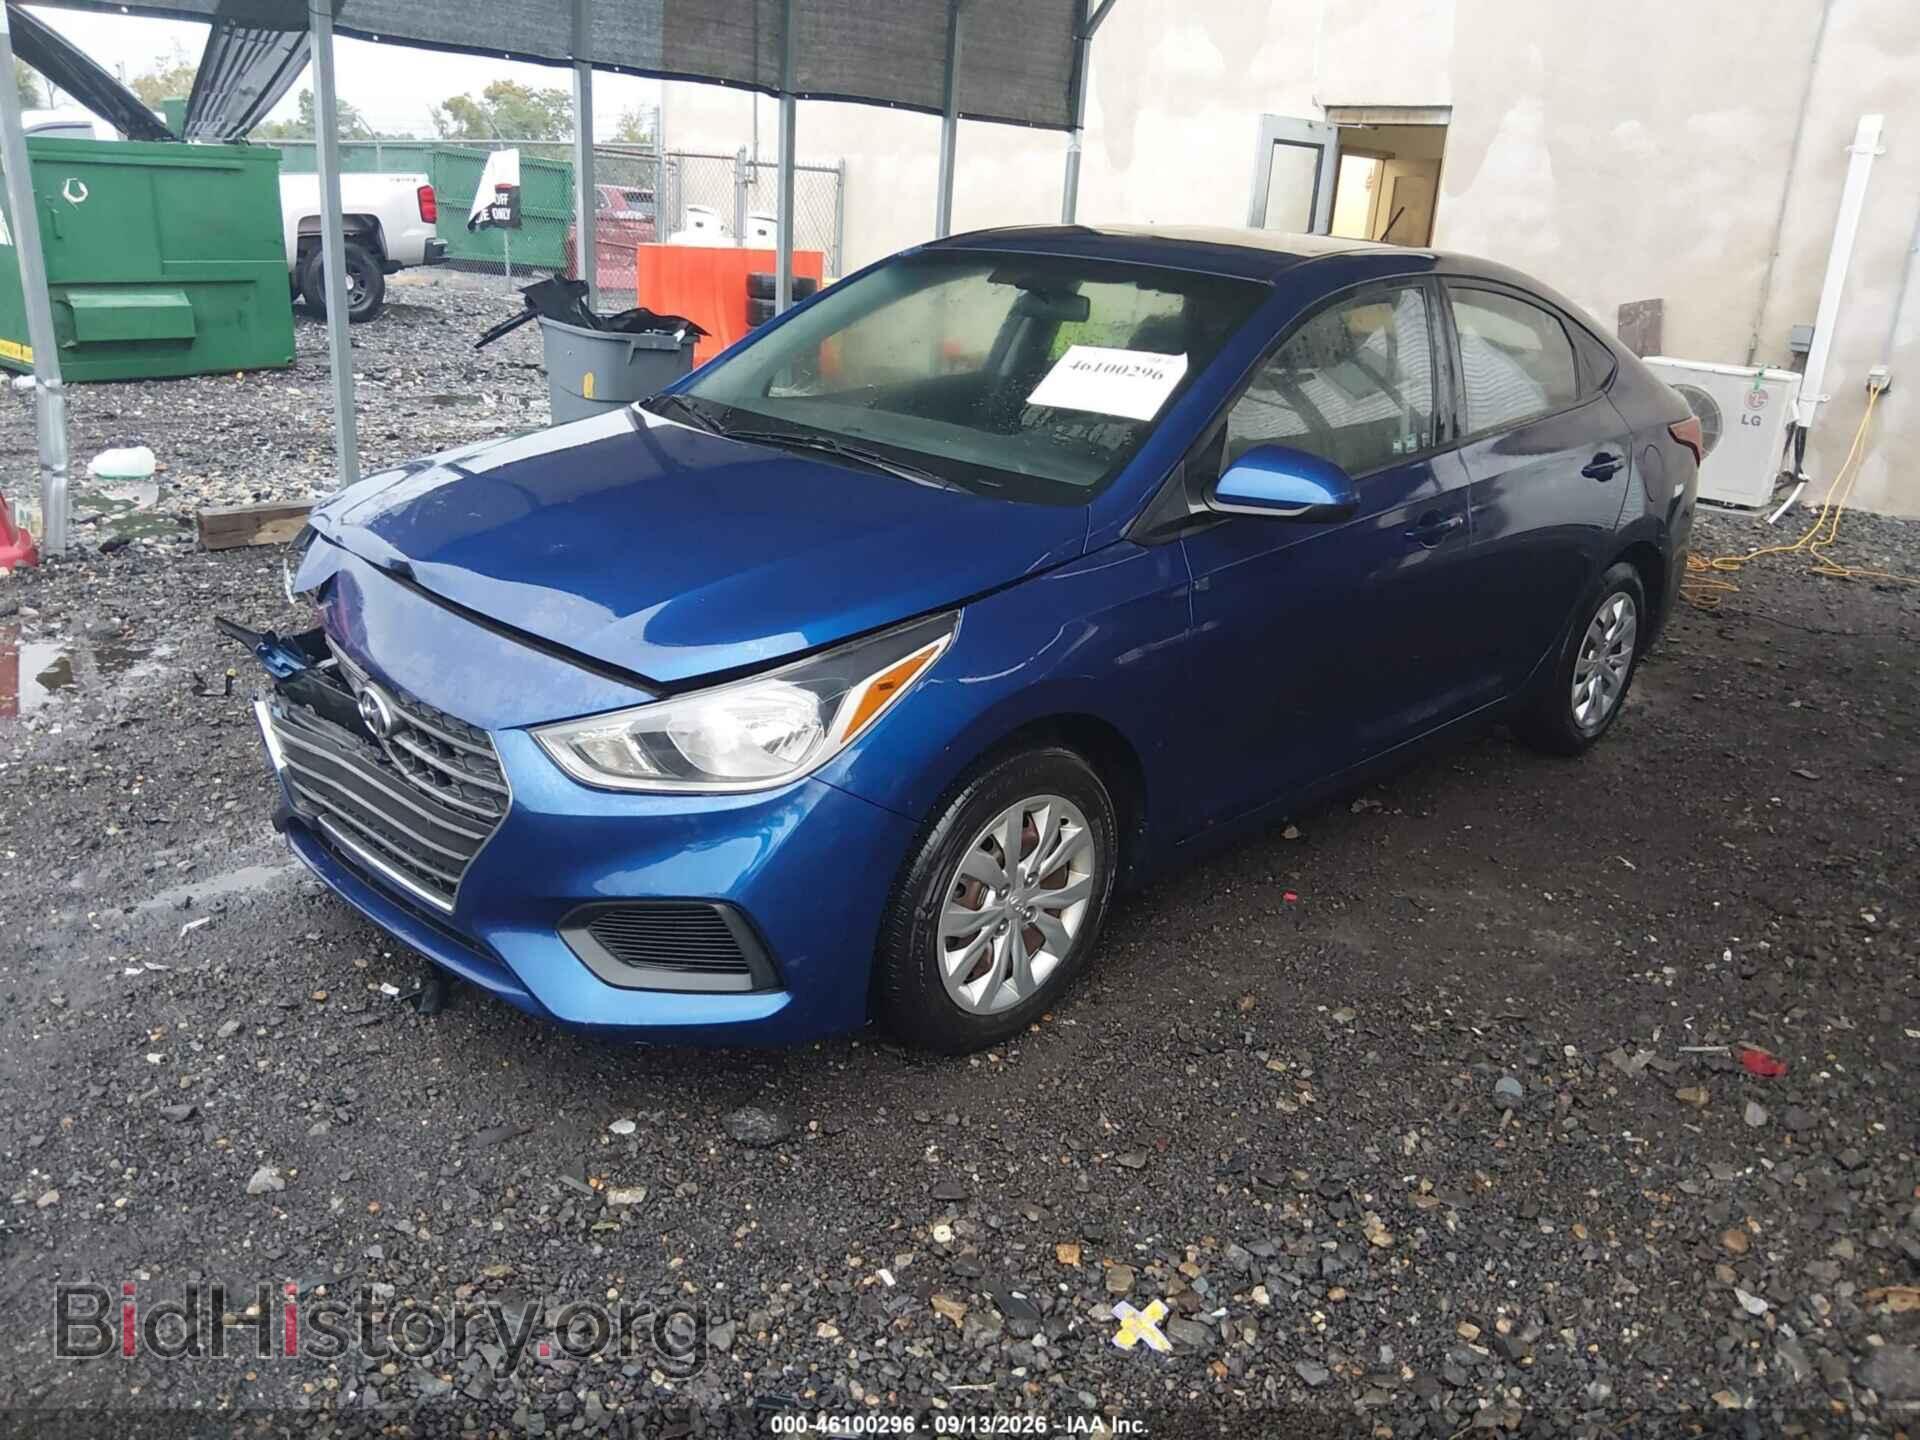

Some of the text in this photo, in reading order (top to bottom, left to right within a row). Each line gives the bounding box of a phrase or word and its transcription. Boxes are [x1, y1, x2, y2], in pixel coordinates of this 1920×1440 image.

[491, 207, 511, 220] ONLY
[1069, 359, 1164, 380] 46100296
[1741, 414, 1761, 426] LG
